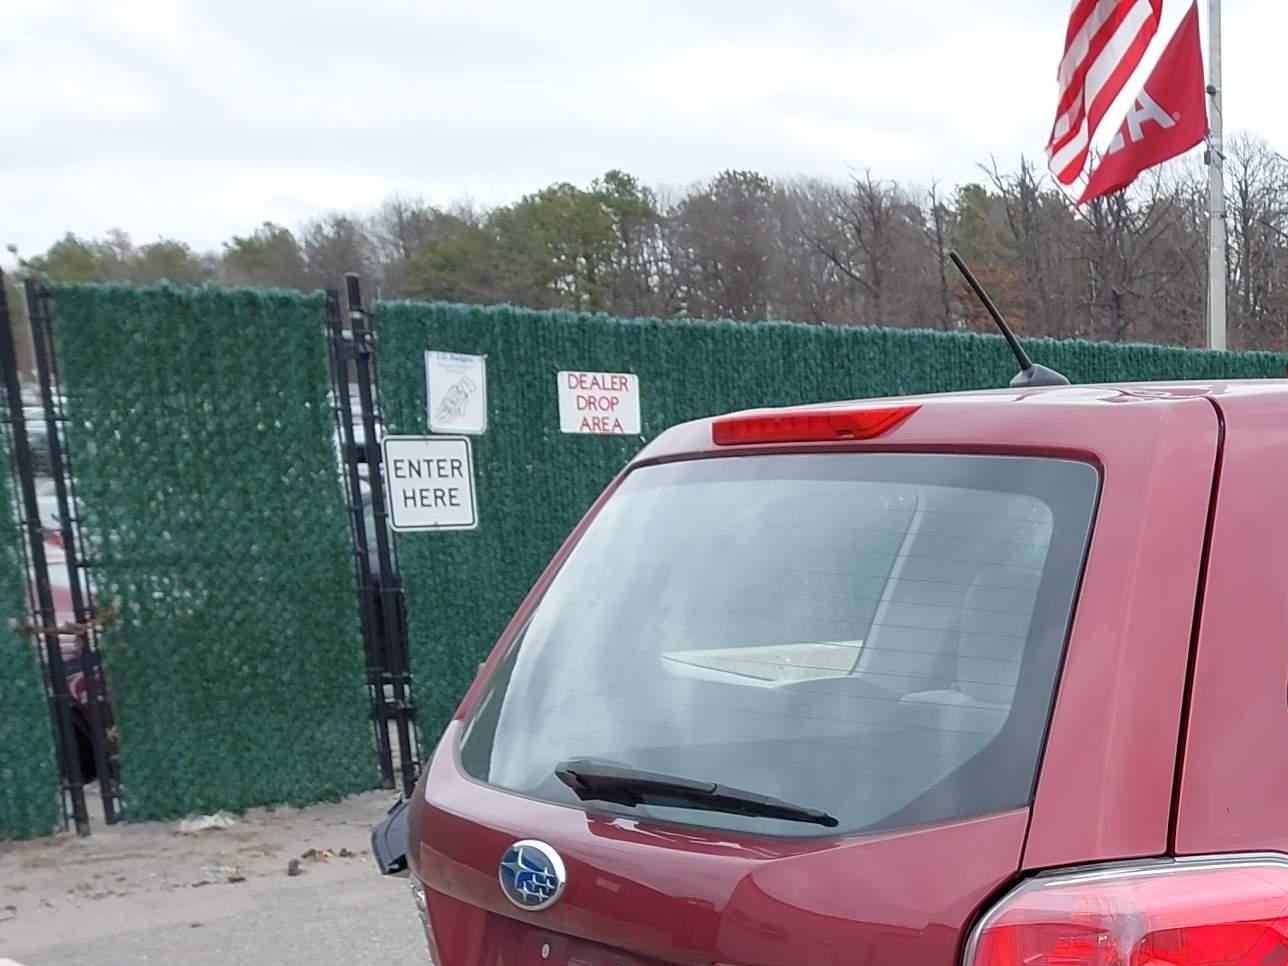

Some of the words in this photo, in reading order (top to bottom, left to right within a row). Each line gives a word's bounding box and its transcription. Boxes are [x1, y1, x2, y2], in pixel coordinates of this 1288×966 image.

[567, 373, 629, 391] DEALER
[577, 395, 620, 412] DROP
[579, 417, 624, 433] AREA
[393, 458, 464, 479] ENTER
[402, 487, 462, 508] HERE
